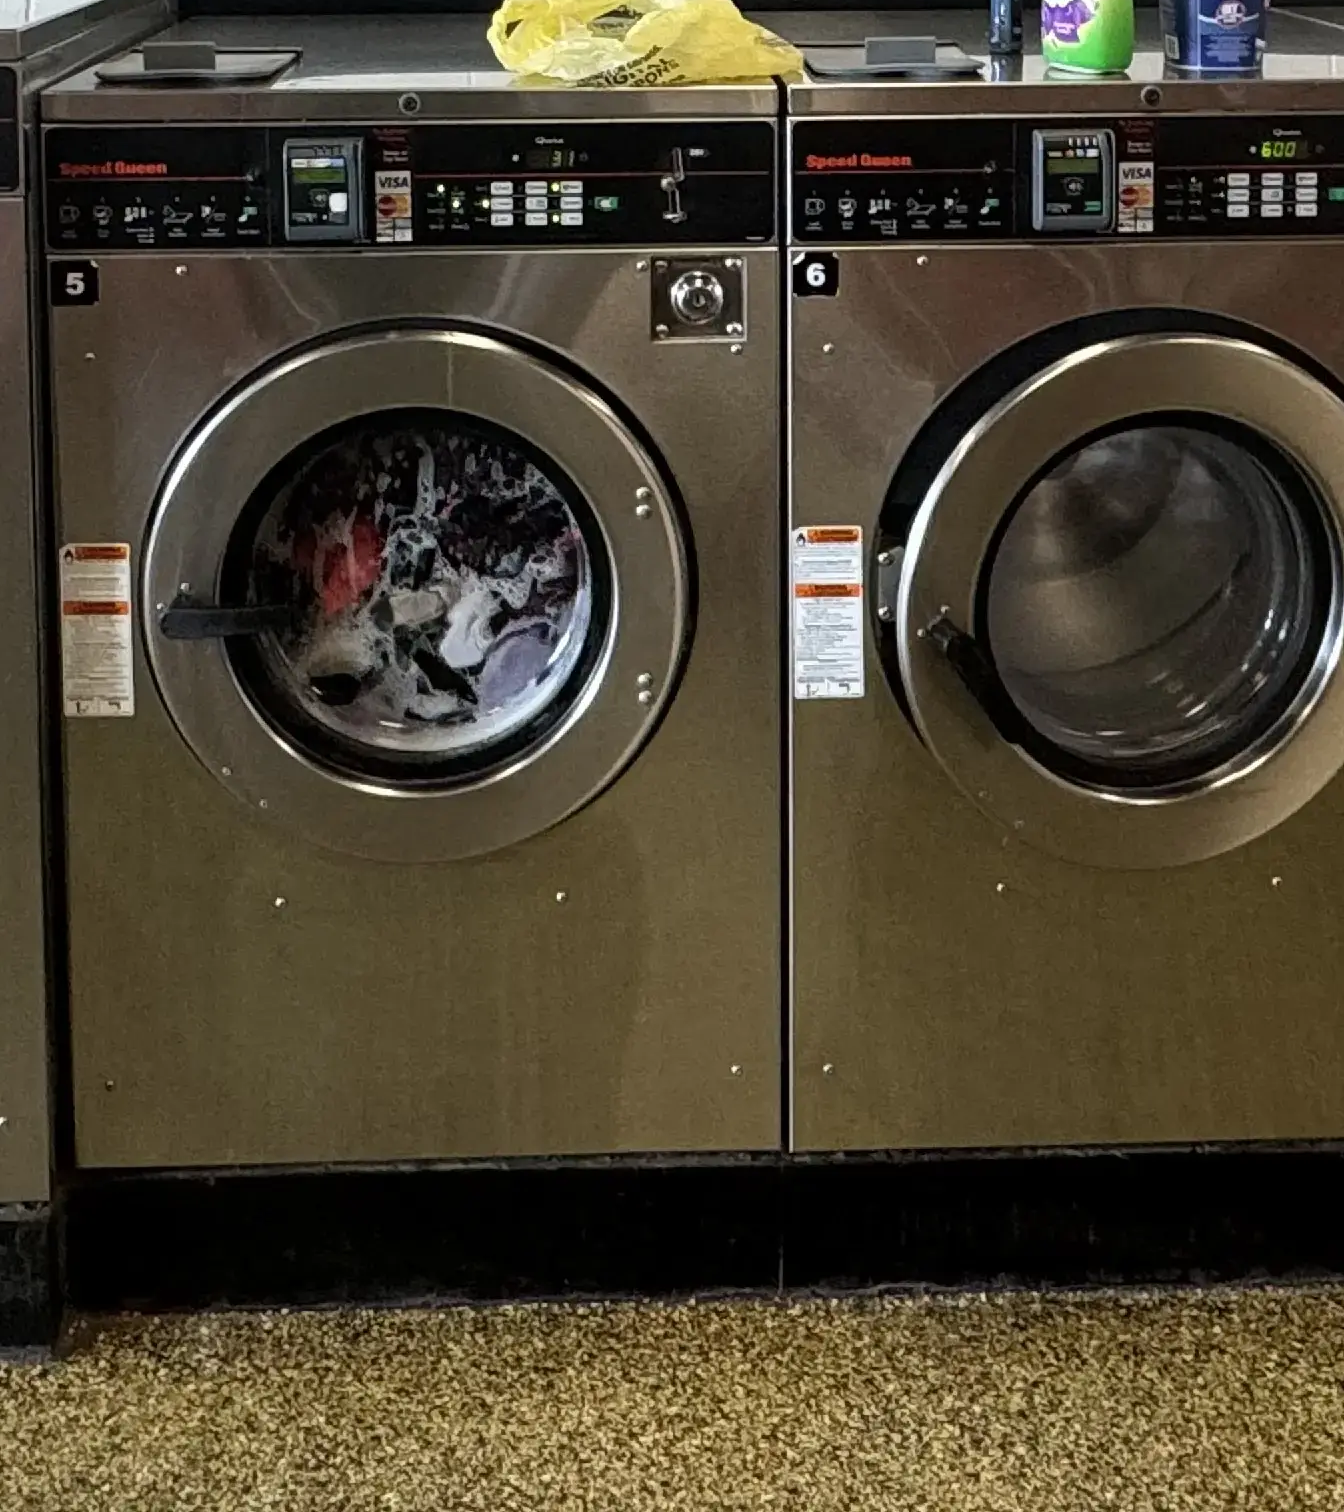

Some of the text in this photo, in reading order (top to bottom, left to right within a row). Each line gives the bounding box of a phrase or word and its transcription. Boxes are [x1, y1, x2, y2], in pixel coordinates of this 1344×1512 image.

[806, 152, 857, 170] Speed
[378, 175, 409, 189] VISA
[1122, 167, 1152, 180] VISA
[65, 272, 86, 295] 5
[806, 262, 826, 287] 6
